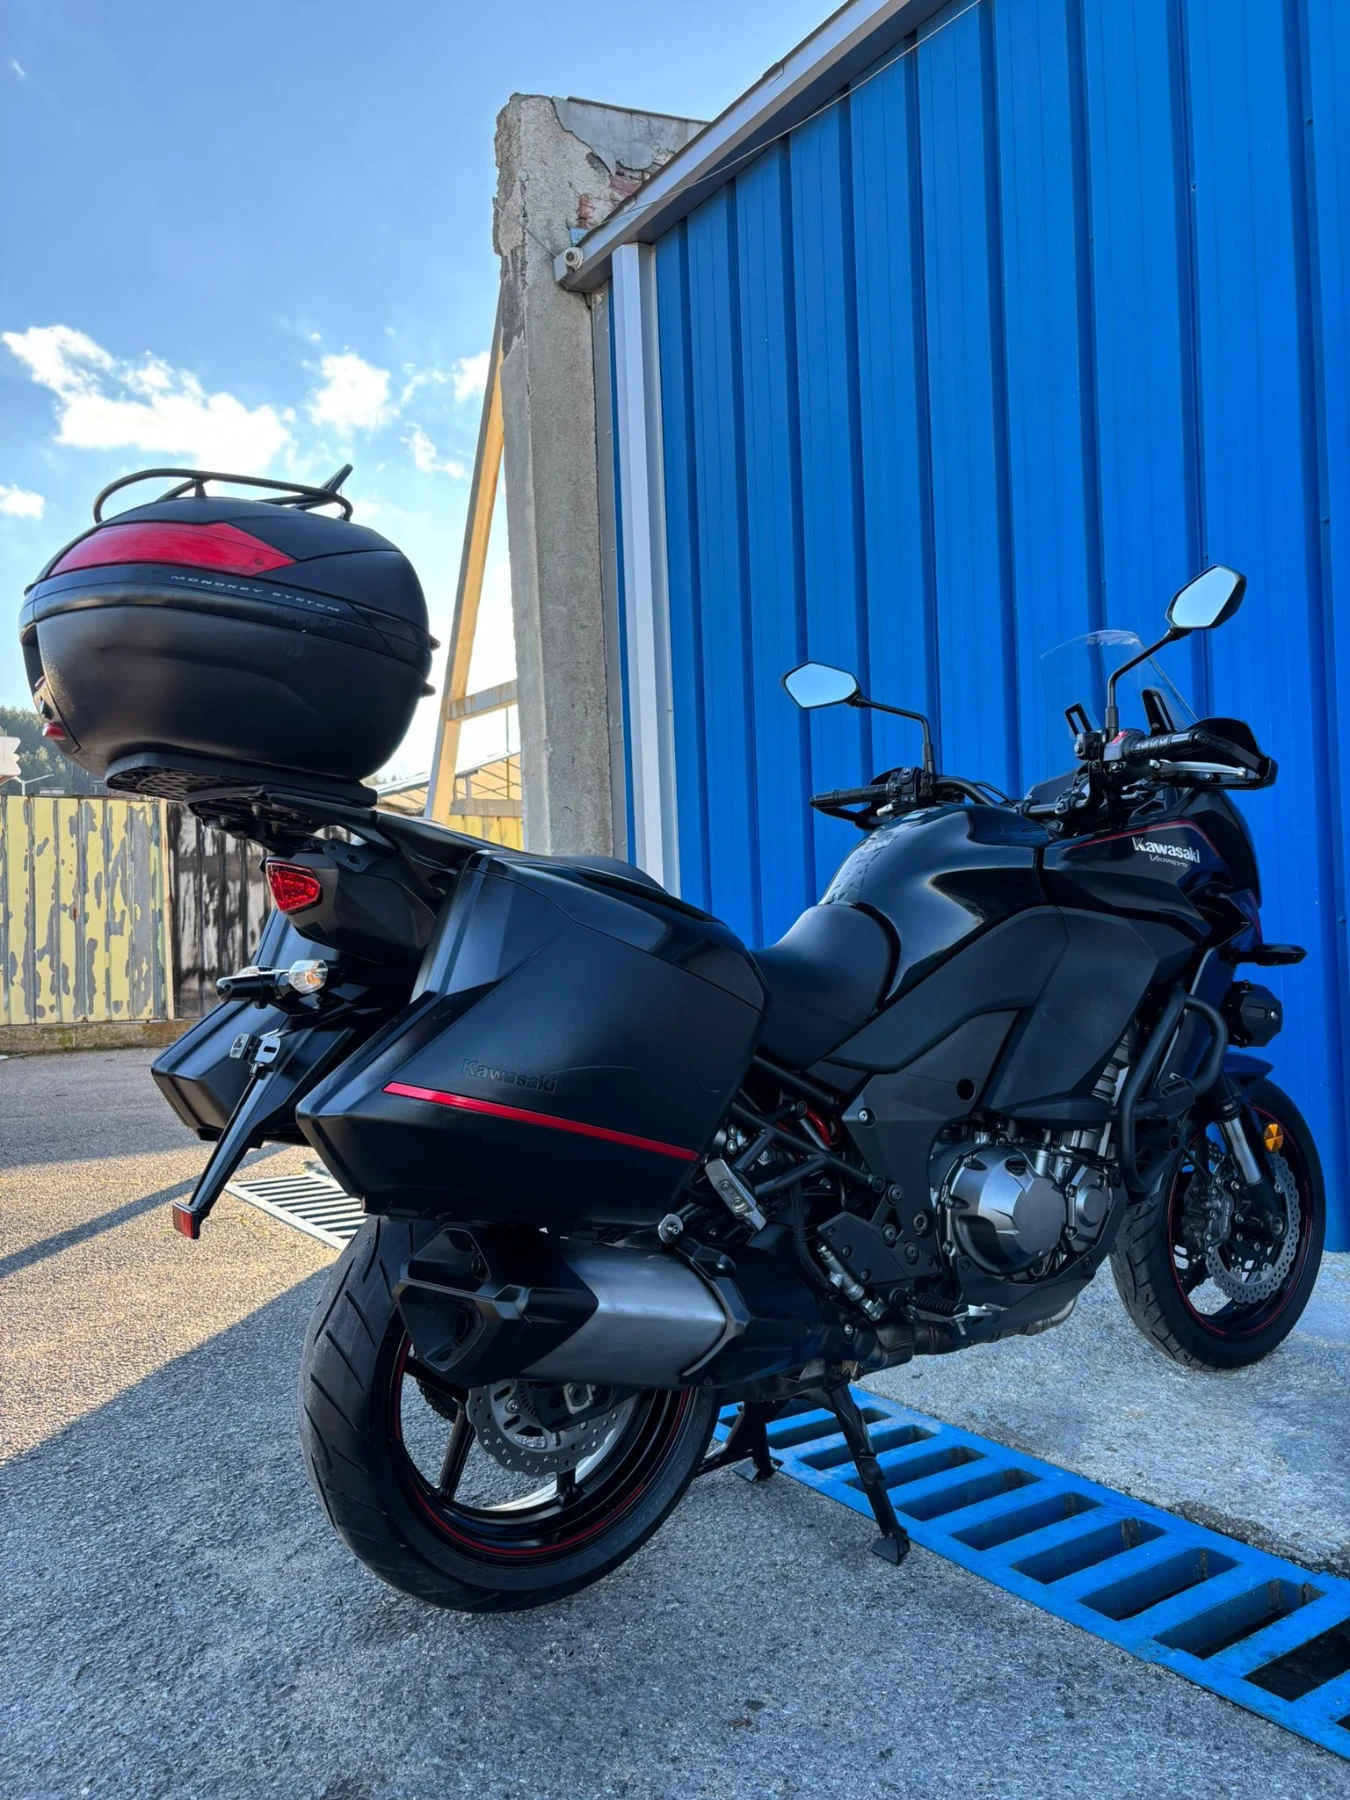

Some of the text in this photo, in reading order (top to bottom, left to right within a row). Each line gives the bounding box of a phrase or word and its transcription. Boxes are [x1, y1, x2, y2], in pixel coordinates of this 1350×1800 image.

[272, 592, 341, 612] SYSTEM
[1132, 836, 1201, 864] Kawasaki
[461, 1058, 558, 1094] Kawasaki
